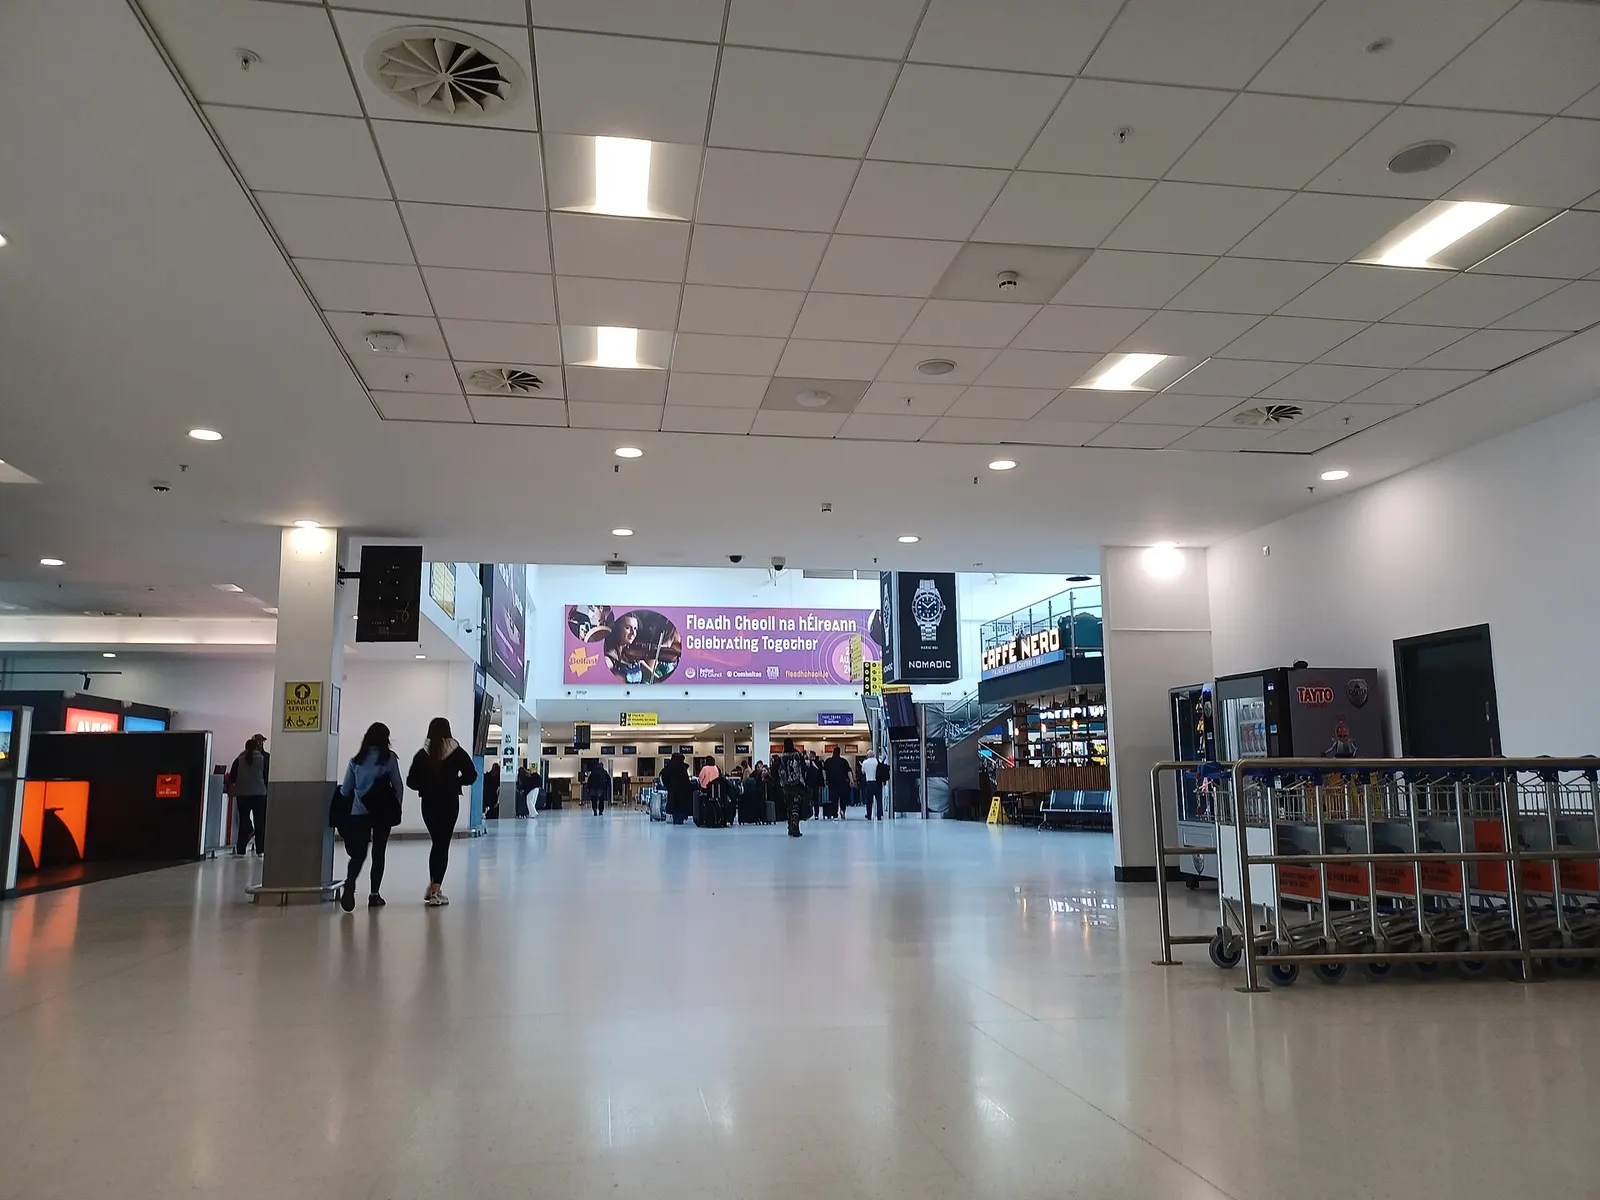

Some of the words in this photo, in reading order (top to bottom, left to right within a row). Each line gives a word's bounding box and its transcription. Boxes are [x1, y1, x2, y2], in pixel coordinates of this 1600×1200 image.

[685, 613, 731, 631] Fleadh
[734, 614, 776, 632] Cheoil
[778, 619, 796, 632] na
[799, 613, 857, 632] hÉireann
[685, 634, 759, 653] Celebrating
[762, 635, 818, 653] Together
[1020, 628, 1061, 660] NERO
[908, 660, 952, 669] NOMADIC
[1296, 686, 1335, 703] TAYTO
